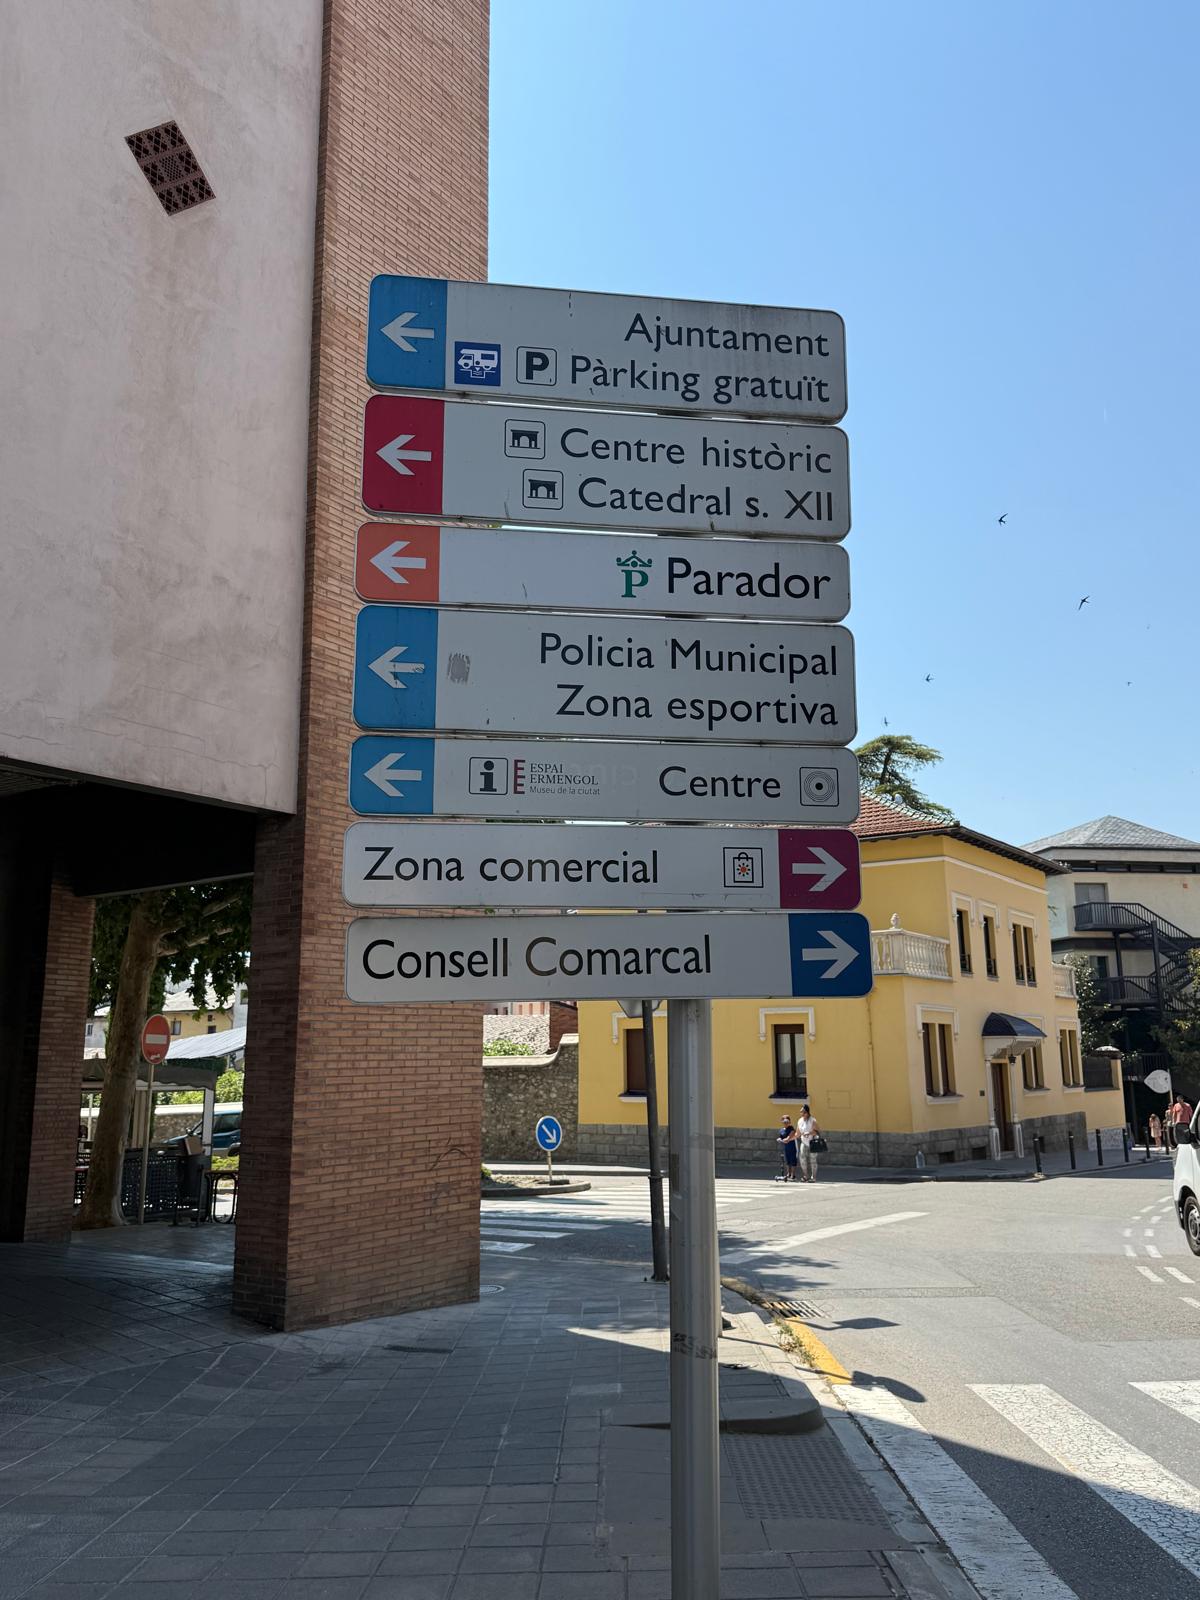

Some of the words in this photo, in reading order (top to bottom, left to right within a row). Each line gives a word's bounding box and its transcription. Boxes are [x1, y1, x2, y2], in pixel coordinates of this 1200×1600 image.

[624, 313, 830, 357] Ajuntament
[525, 351, 550, 380] P
[571, 355, 700, 402] Pàrking
[713, 375, 830, 405] gratuït
[561, 428, 685, 464] Centre
[703, 437, 832, 473] històric
[579, 477, 730, 516] Catedral
[746, 497, 769, 518] s.
[784, 490, 833, 521] XII
[668, 557, 831, 599] Parador
[541, 633, 654, 668] Policia
[671, 639, 837, 683] Municipal
[556, 684, 652, 719] Zona
[668, 694, 838, 731] esportiva
[529, 774, 599, 786] ERMENGOL
[530, 763, 563, 774] ESPAI
[659, 766, 780, 798] Centre
[529, 786, 556, 794] Museu
[557, 786, 567, 795] de
[569, 786, 576, 795] la
[577, 787, 601, 796] ciutat
[363, 847, 464, 881] Zona
[480, 850, 657, 884] comercial
[363, 938, 508, 979] Consell
[526, 935, 711, 976] Comarcal
